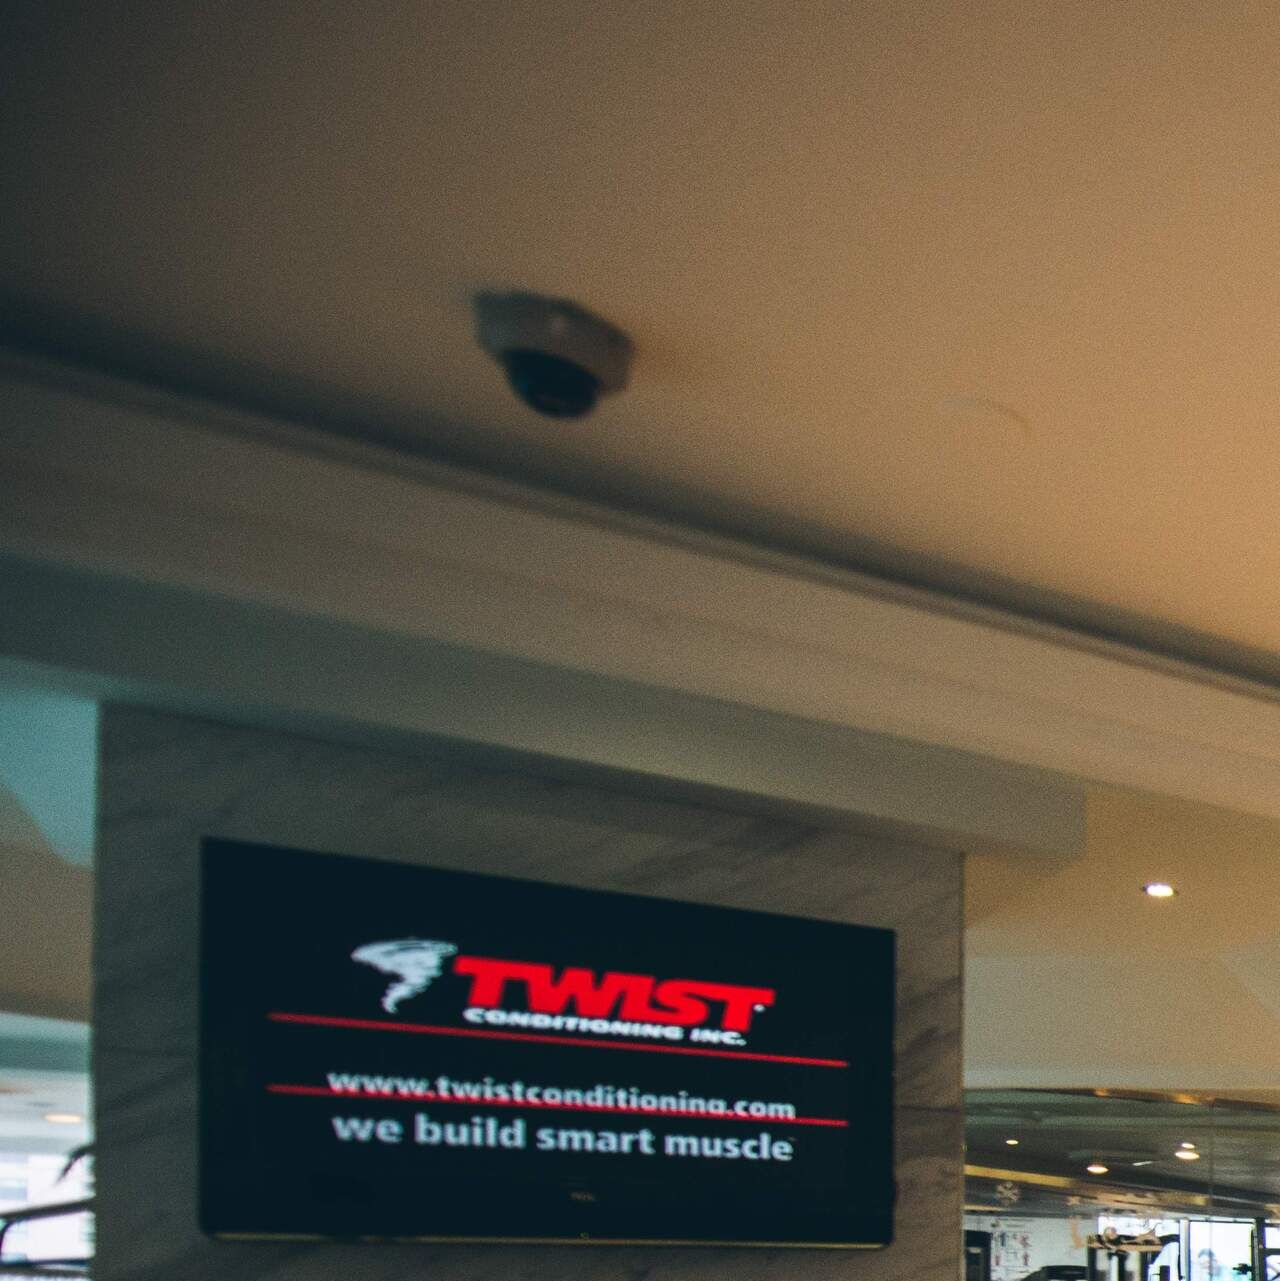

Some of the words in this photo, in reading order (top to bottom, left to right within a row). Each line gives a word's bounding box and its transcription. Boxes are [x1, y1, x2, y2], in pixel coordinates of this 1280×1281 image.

[453, 955, 775, 1032] TWIST
[462, 1007, 685, 1041] CONDITIONING
[689, 1027, 747, 1046] INC.
[331, 1115, 403, 1143] we
[414, 1112, 526, 1148] build
[536, 1128, 655, 1154] smart
[664, 1133, 794, 1161] muscle
